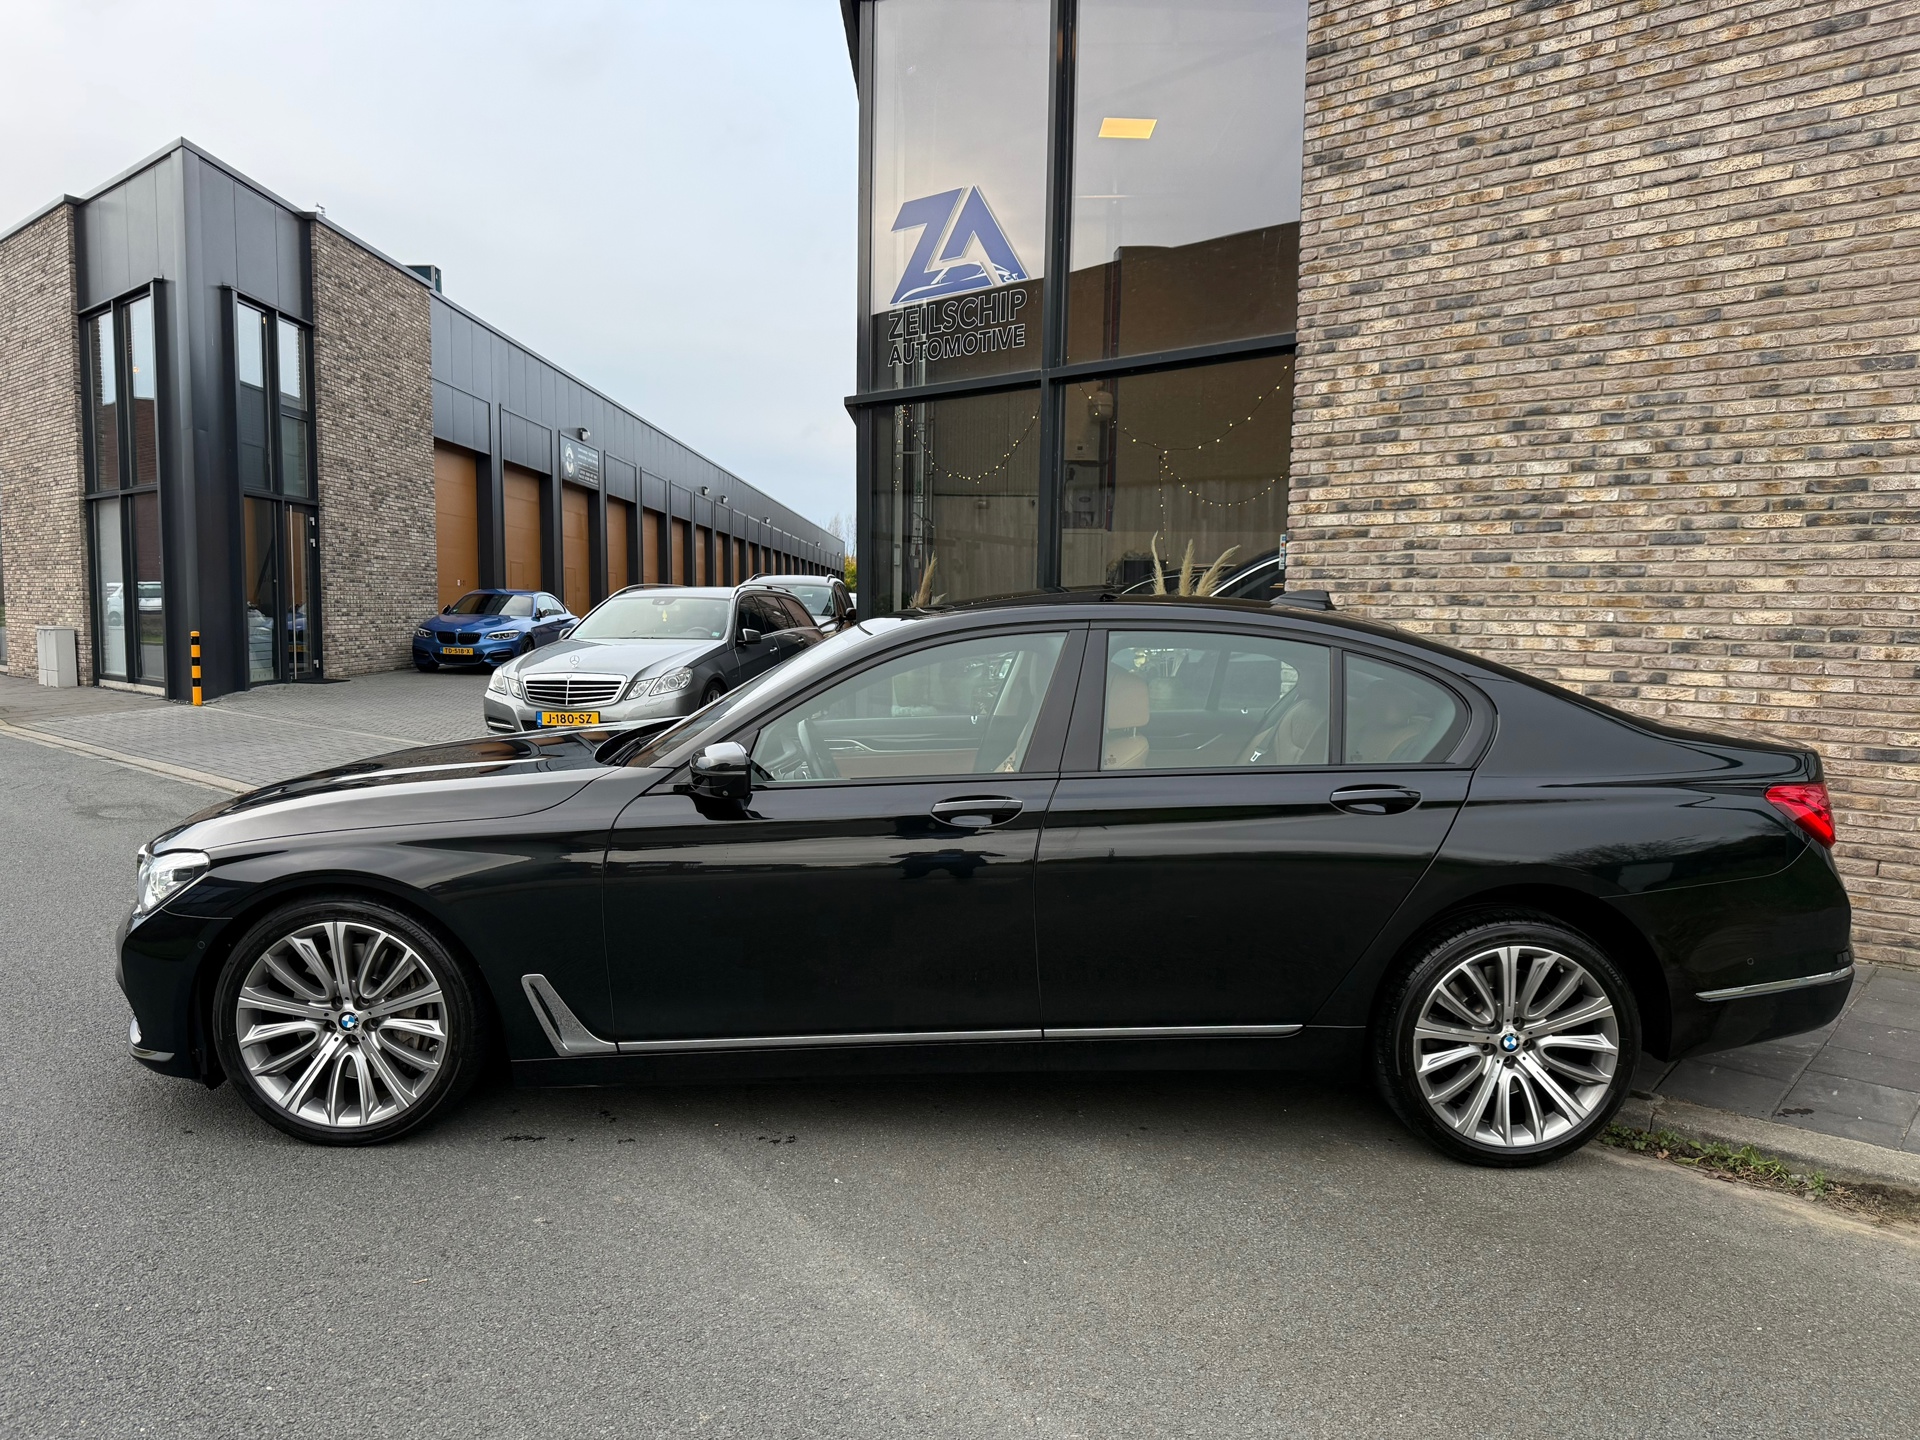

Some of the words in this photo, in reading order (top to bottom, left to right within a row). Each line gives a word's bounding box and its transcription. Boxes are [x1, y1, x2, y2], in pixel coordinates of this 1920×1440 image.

[890, 184, 1029, 305] ZA
[888, 289, 1027, 341] ZEILSCHIP
[888, 324, 1025, 367] AUTOMOTIVE
[547, 714, 592, 724] J-180-SZ
